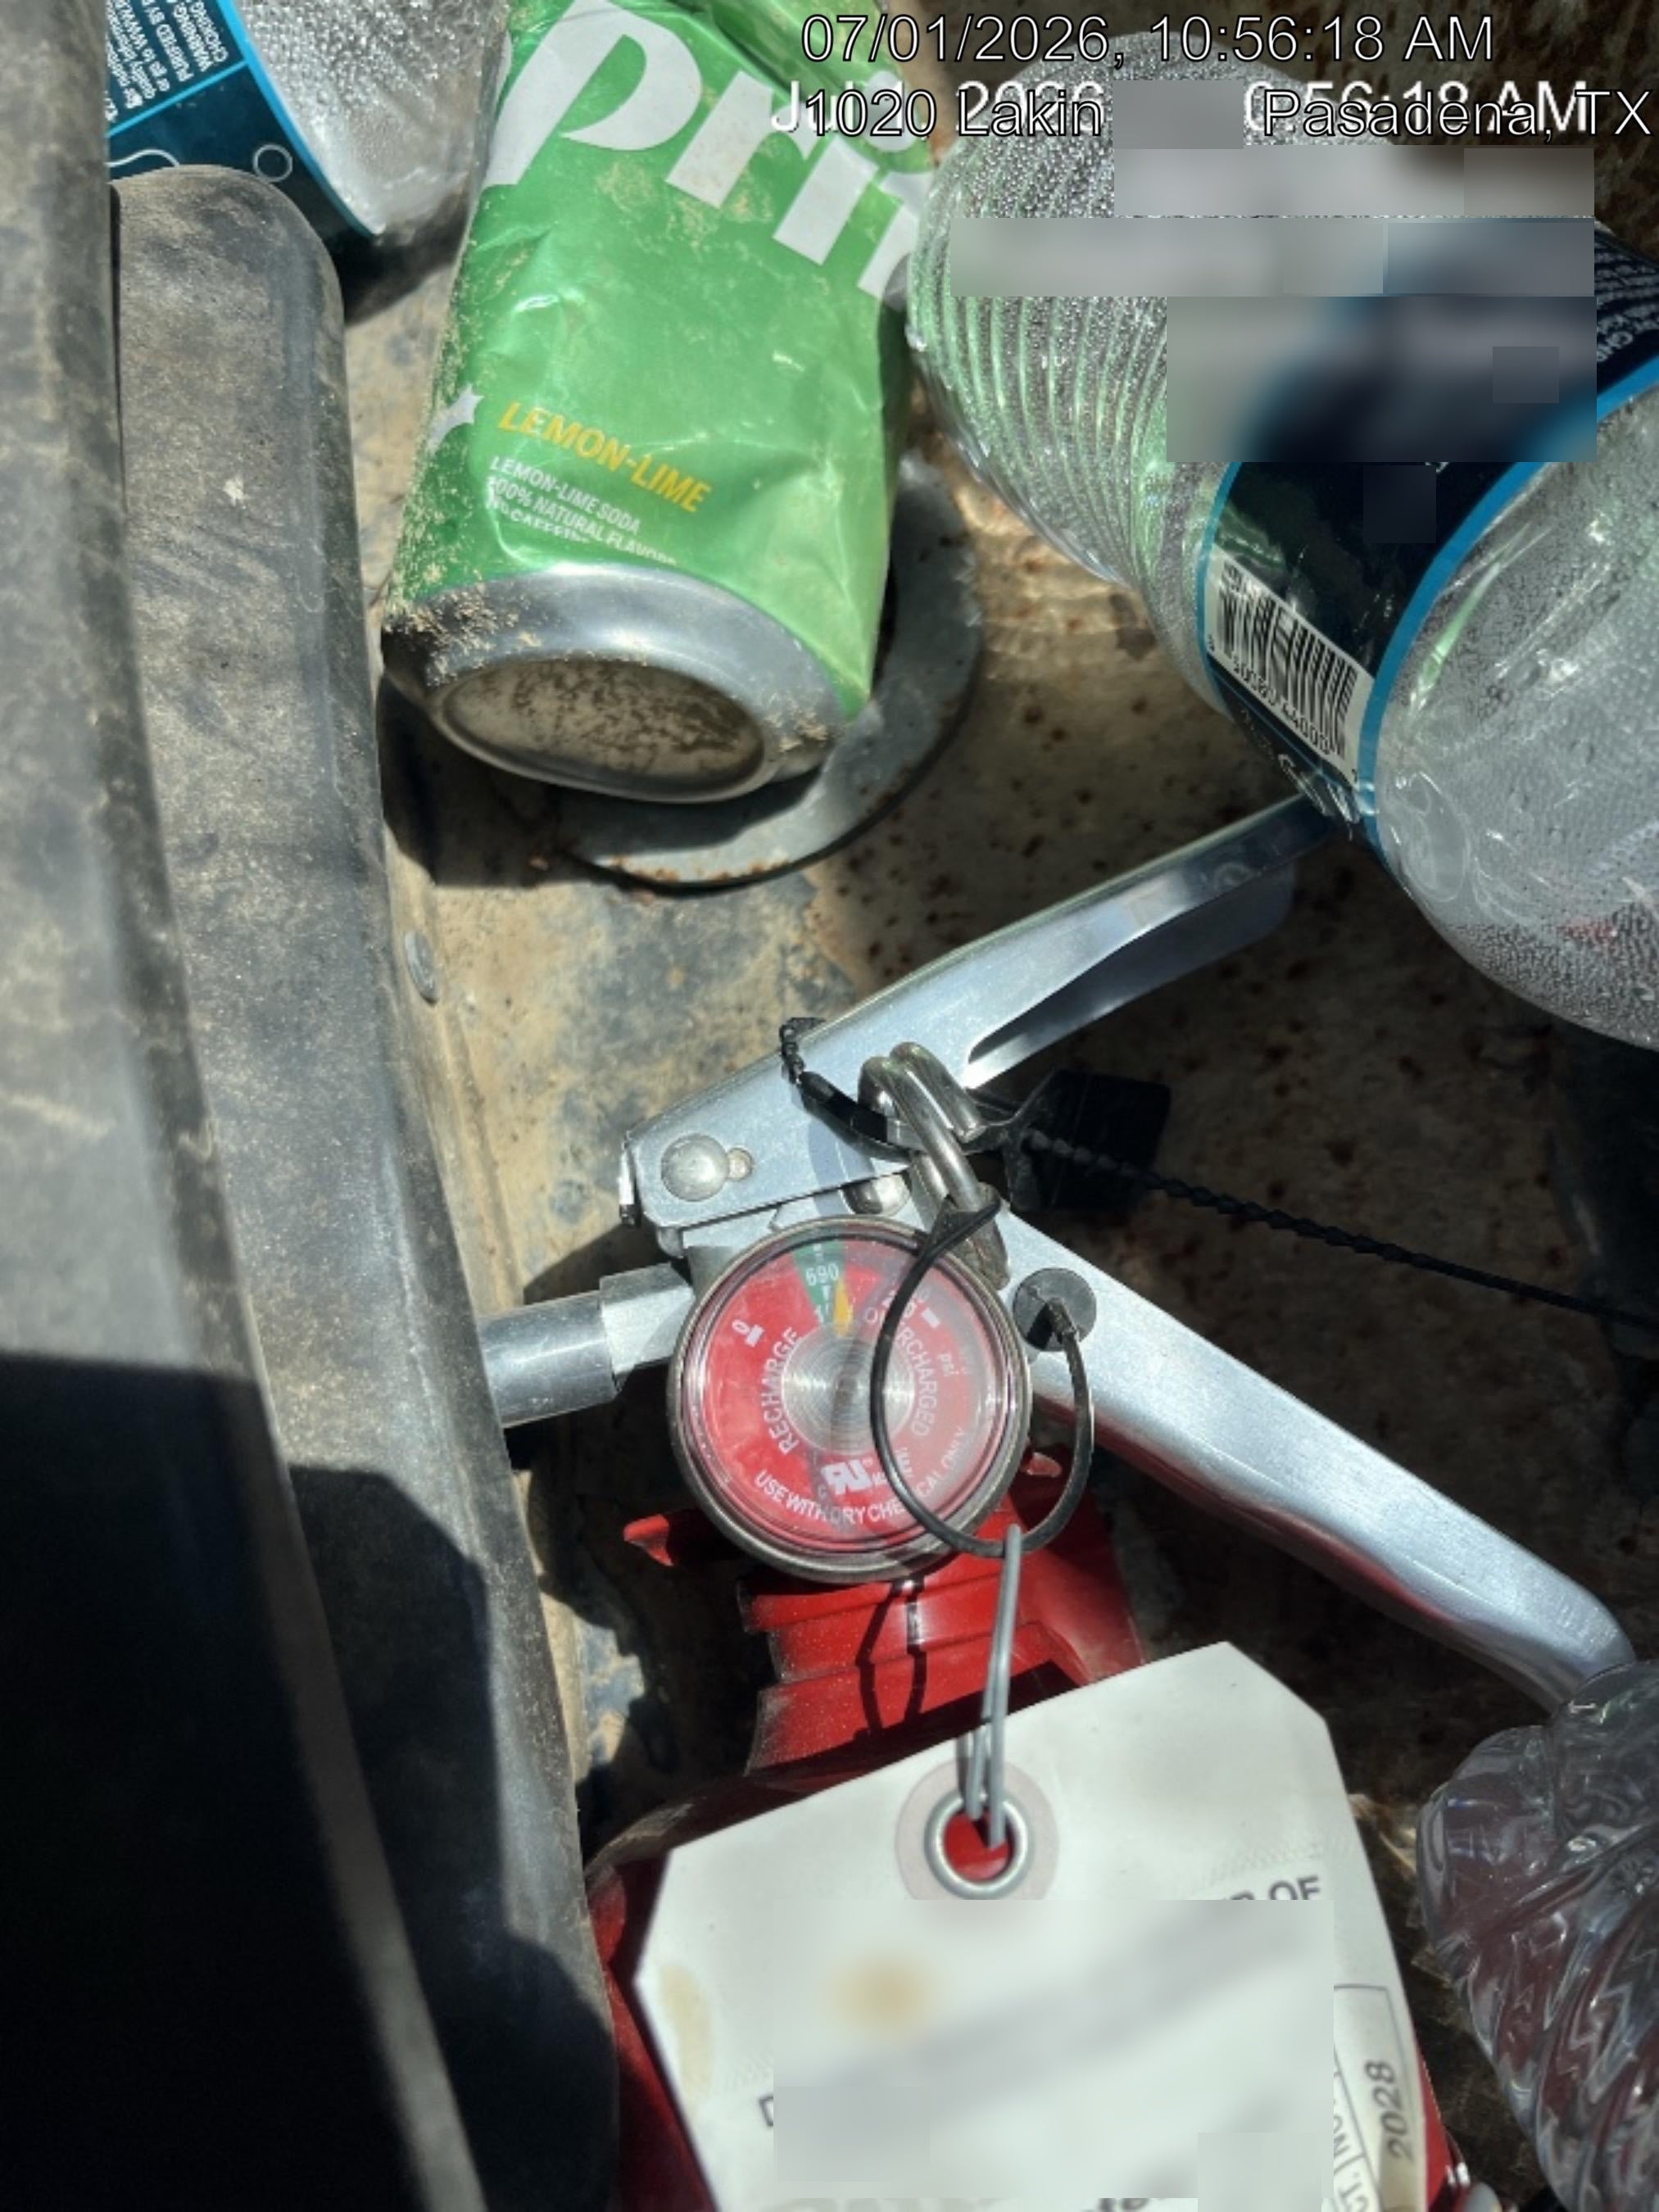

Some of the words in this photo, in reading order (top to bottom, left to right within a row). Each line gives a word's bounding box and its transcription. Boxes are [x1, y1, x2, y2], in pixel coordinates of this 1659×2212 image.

[490, 456, 601, 513] LEMON-LIME
[597, 503, 642, 535] SODA
[497, 401, 713, 513] LEMON-LIME
[533, 496, 605, 542] NATURAL
[760, 1326, 800, 1456] RECHARGE
[754, 1469, 789, 1503] USE
[1364, 2060, 1416, 2161] 2028
